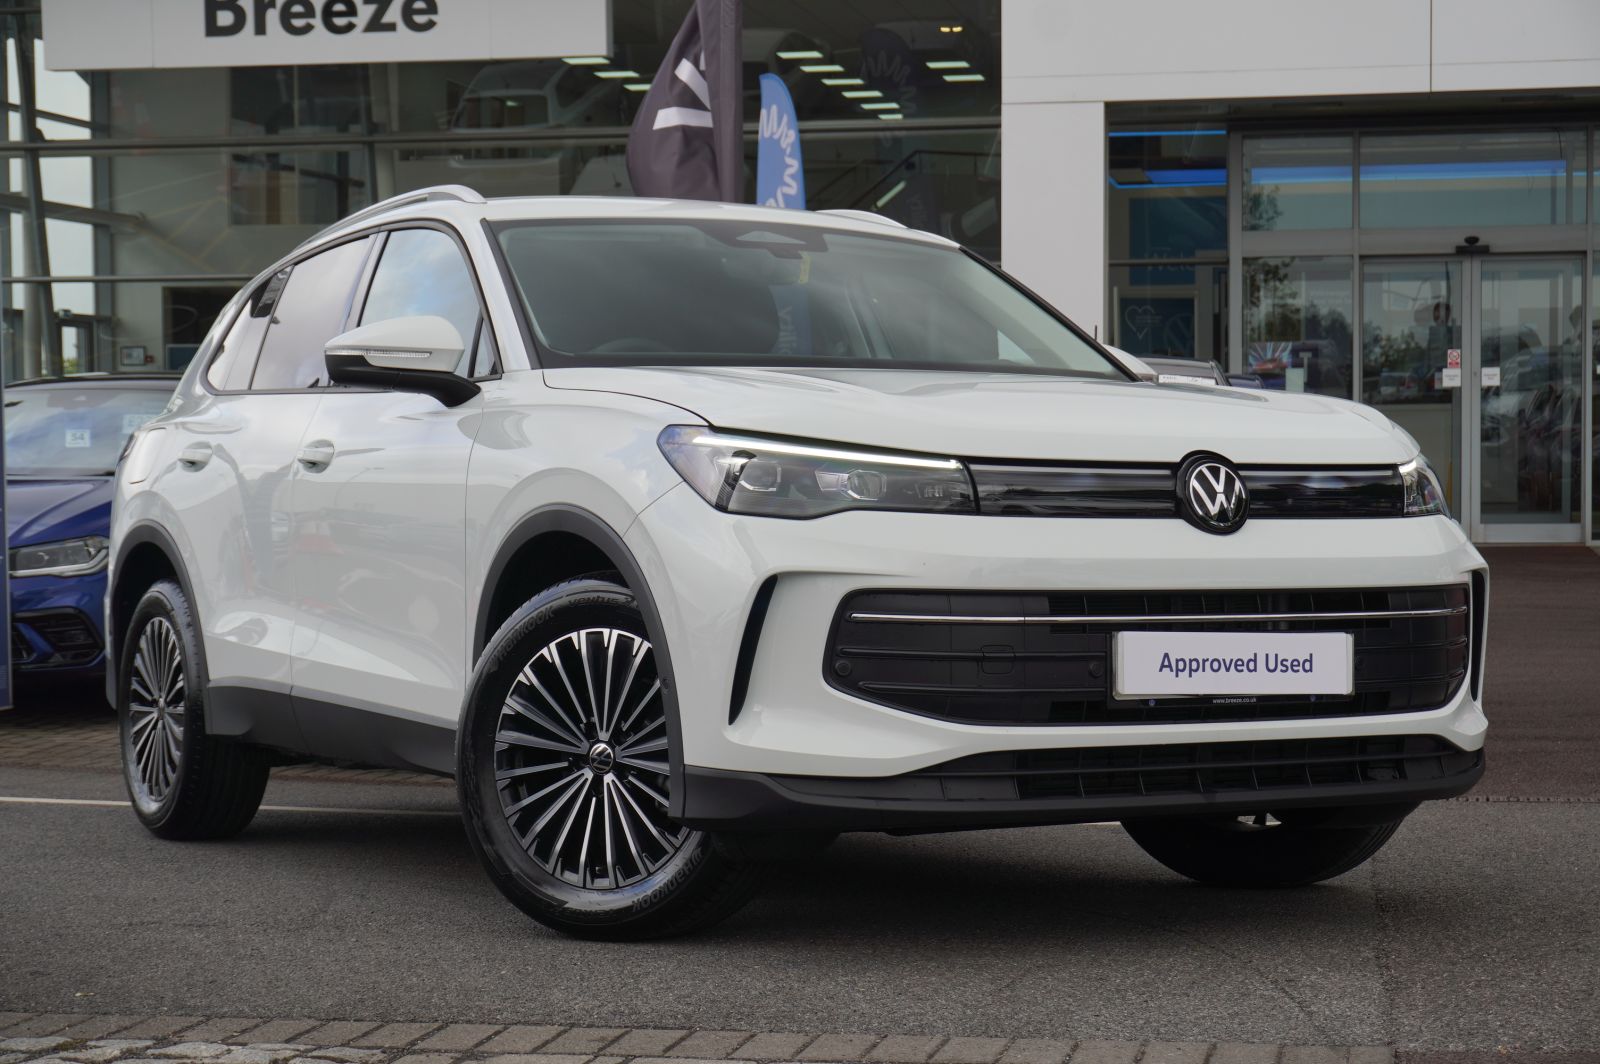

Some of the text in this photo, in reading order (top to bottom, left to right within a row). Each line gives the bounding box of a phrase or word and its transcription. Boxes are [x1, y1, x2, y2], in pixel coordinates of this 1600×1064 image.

[204, 0, 438, 37] Breeze
[1158, 651, 1314, 677] Approved Used
